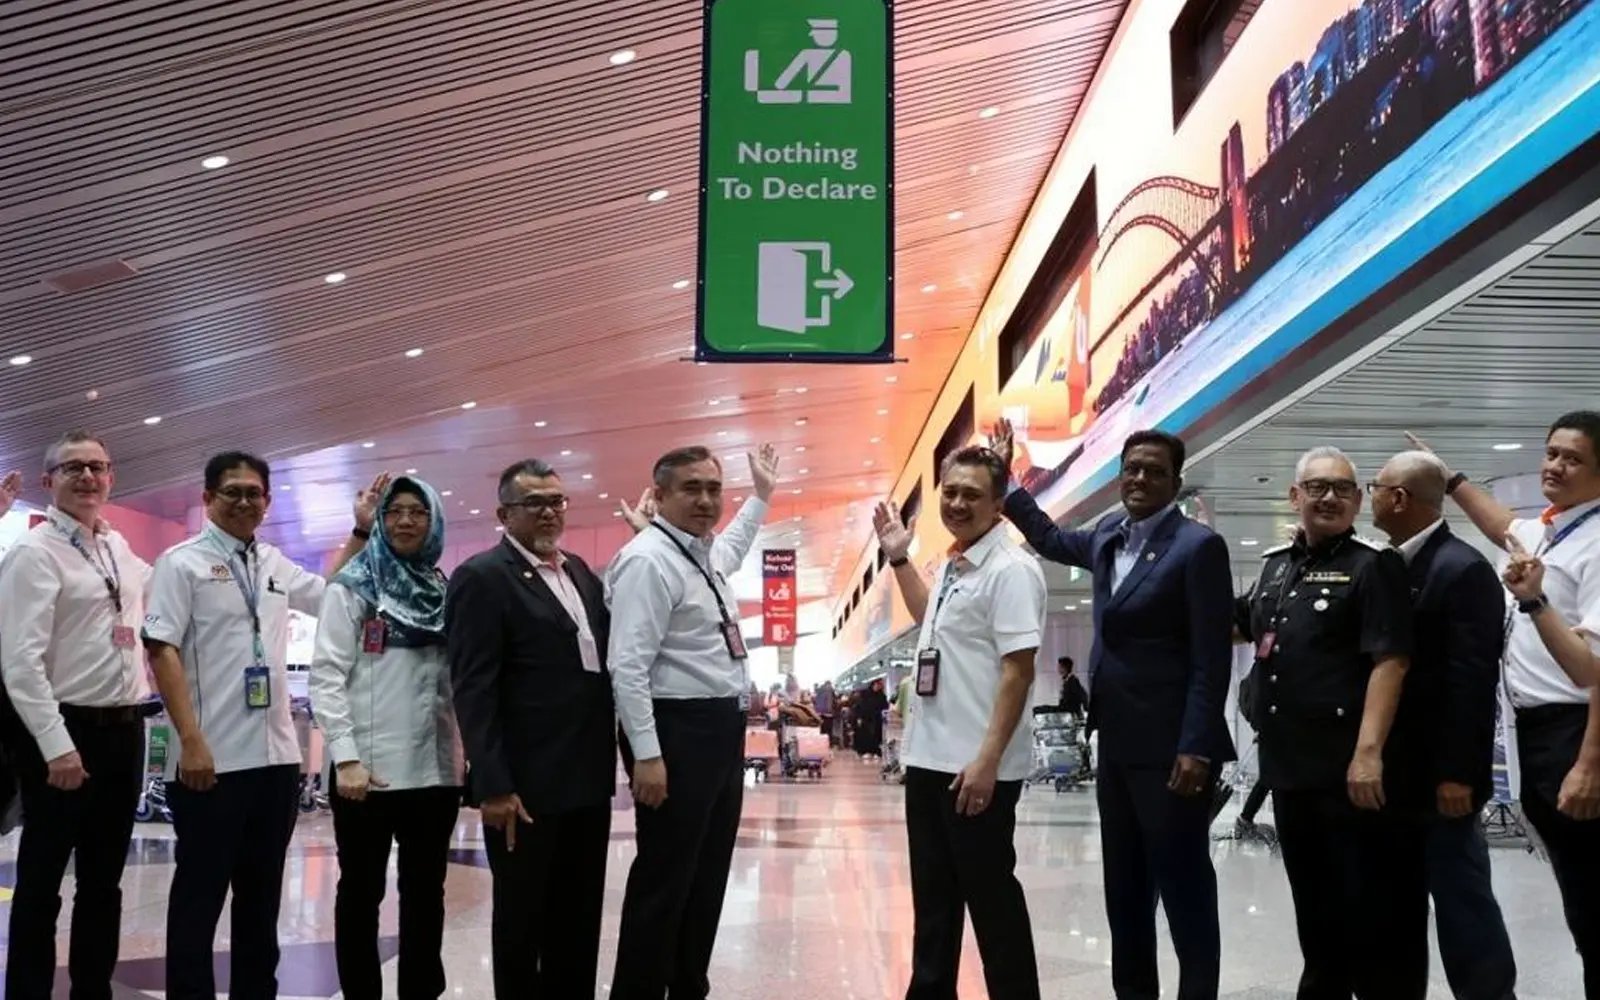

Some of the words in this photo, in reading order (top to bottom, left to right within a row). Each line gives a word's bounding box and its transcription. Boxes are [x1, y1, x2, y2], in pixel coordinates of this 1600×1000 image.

[738, 141, 857, 169] Nothing
[717, 177, 752, 199] To
[763, 177, 876, 200] Declare
